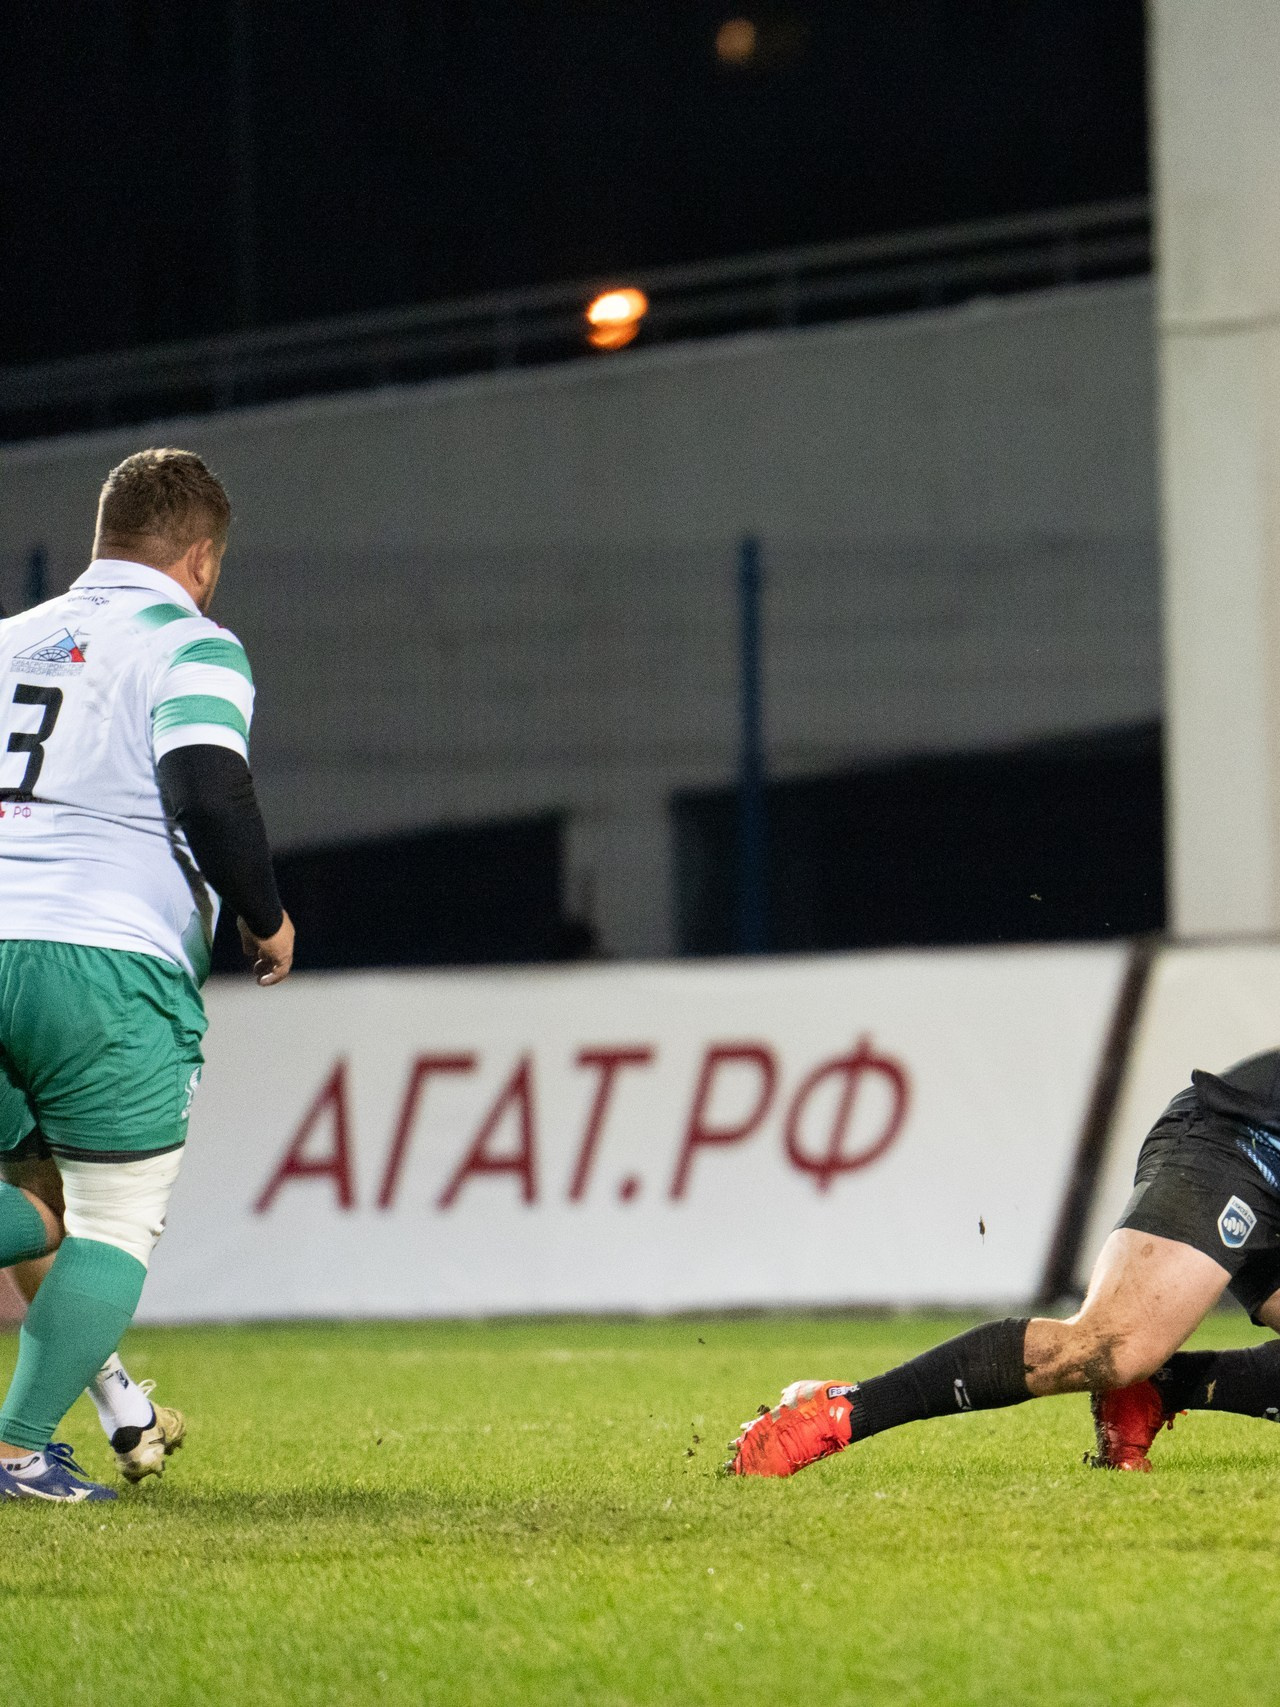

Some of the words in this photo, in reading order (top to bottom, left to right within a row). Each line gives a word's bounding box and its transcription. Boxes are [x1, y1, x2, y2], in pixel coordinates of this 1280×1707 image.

[0, 683, 63, 802] 3
[13, 805, 32, 819] РФ
[252, 1033, 912, 1214] АГАТ.РФ
